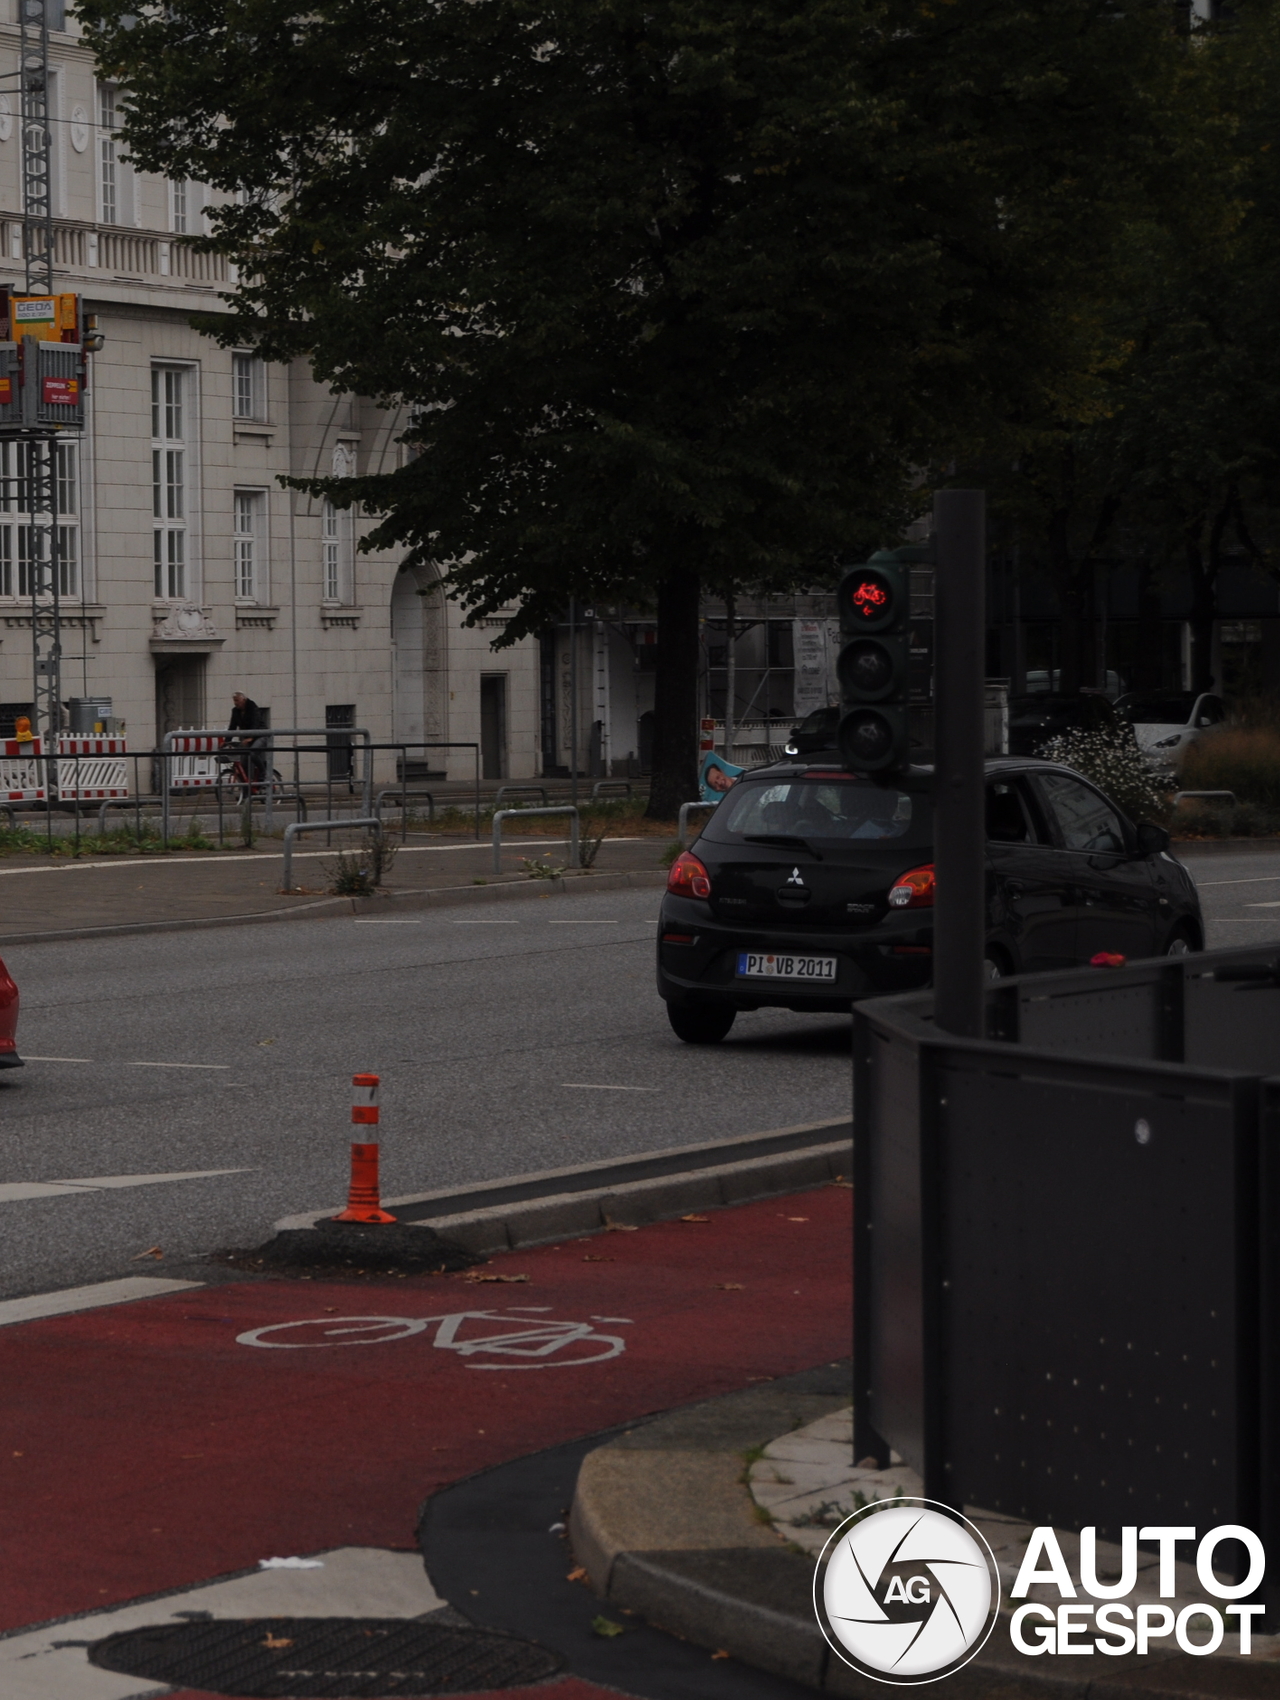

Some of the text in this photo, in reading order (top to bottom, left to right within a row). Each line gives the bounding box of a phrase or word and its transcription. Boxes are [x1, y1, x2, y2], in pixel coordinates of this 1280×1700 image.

[46, 381, 66, 389] ZEPPELIN
[747, 956, 763, 973] PI
[776, 957, 794, 975] VB
[797, 959, 833, 977] 2011
